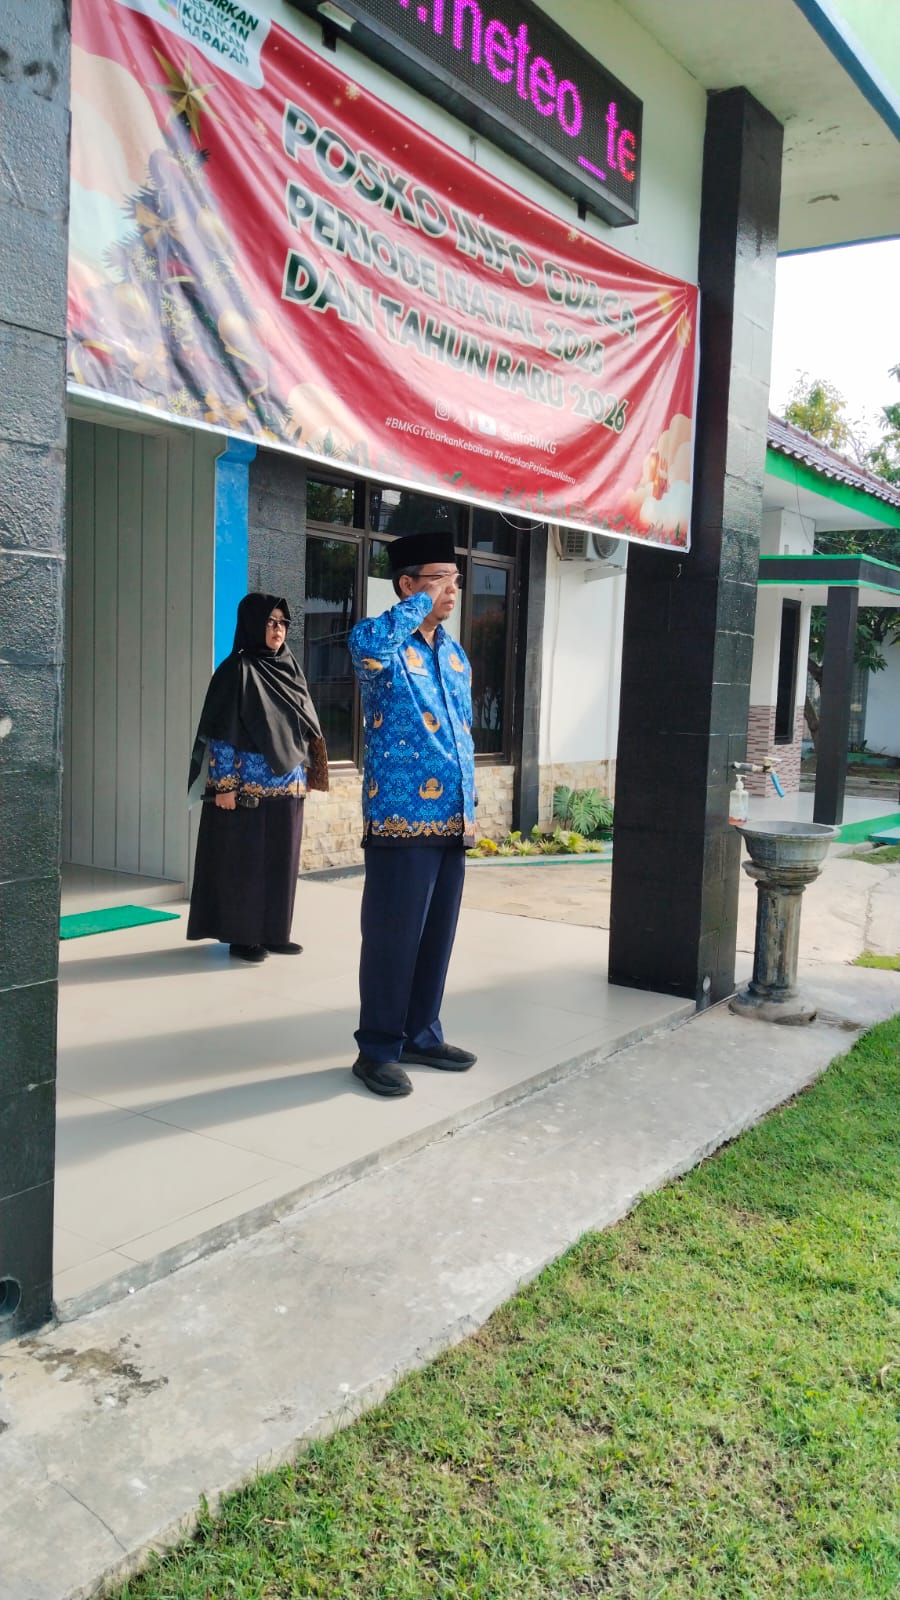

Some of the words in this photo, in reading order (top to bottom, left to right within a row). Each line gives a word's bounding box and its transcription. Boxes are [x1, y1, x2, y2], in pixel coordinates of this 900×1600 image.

[181, 19, 249, 66] HARAPAN
[182, 3, 247, 53] KUATKAN
[282, 99, 448, 238] POSKO
[450, 206, 540, 287] INFO
[542, 260, 637, 343] CUACA
[286, 179, 441, 300] PERIODE
[444, 271, 543, 348] NATAL
[544, 320, 605, 376] 2025
[281, 248, 377, 331] DAN
[378, 294, 490, 381] TAHUN
[494, 350, 565, 409] BARU
[570, 384, 629, 434] 2026
[385, 416, 494, 457] #BMKGTebarkanKebaikan
